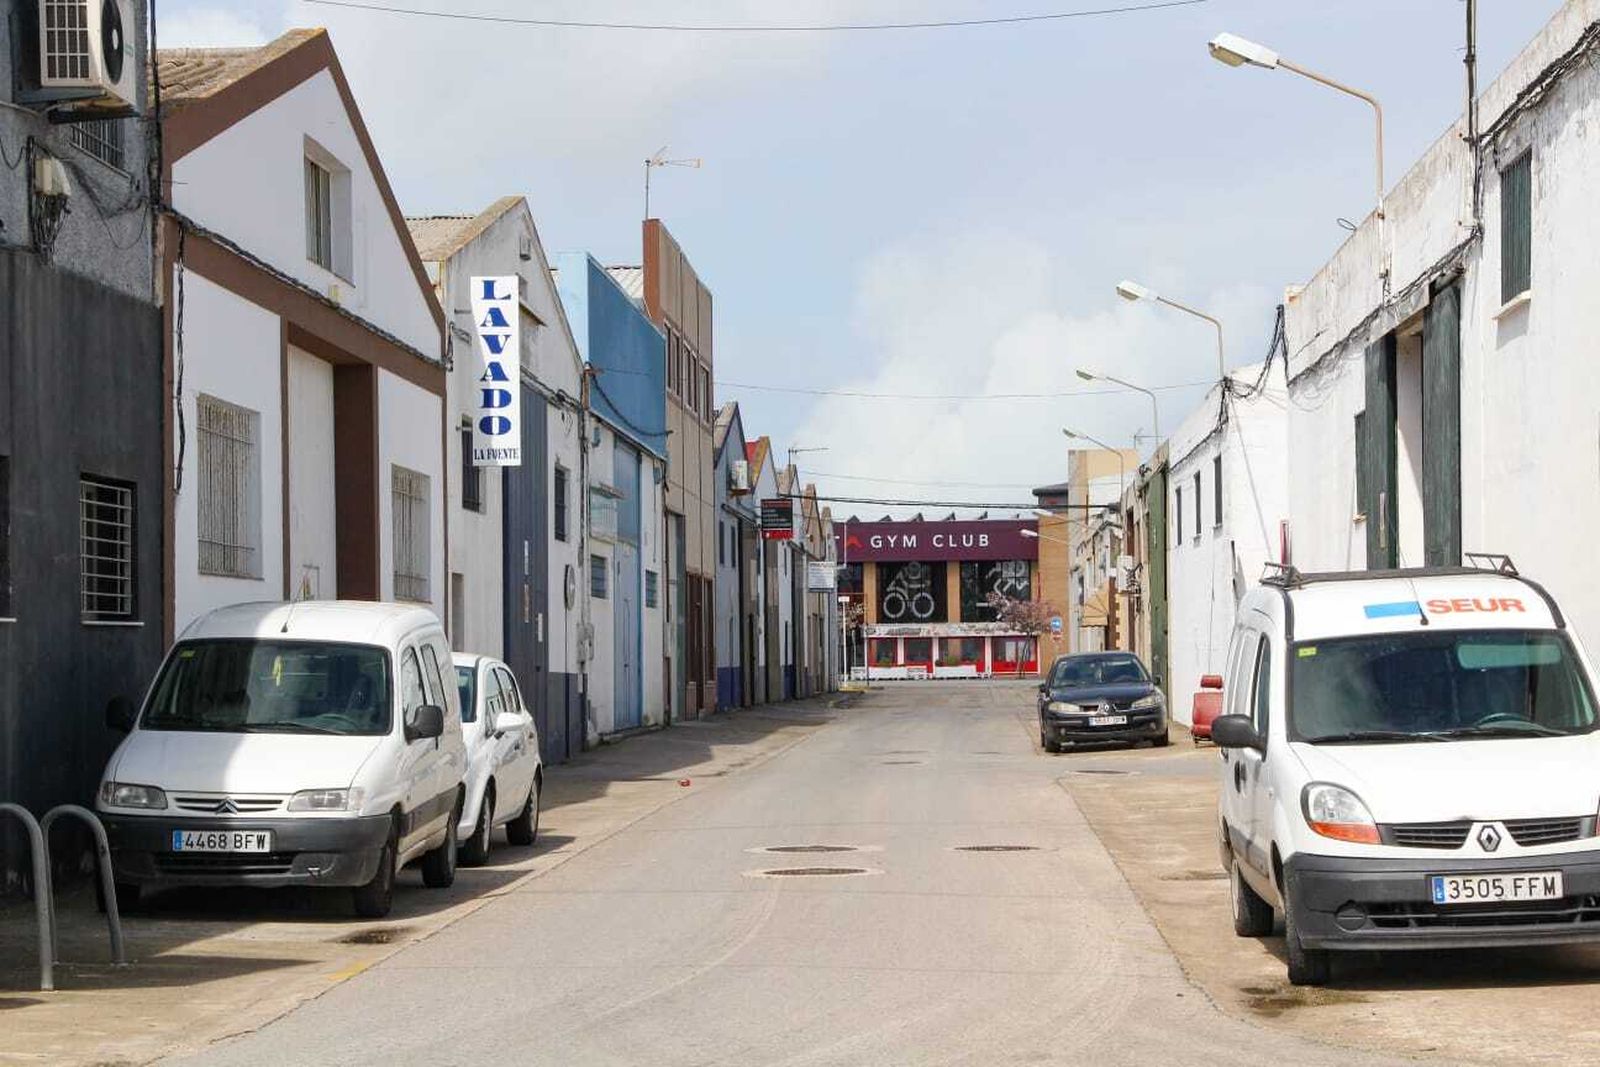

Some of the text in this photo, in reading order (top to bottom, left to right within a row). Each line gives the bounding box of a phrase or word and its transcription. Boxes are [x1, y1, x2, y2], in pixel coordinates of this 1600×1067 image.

[478, 279, 513, 436] LAVADO
[474, 447, 520, 460] LA FUENTE
[870, 533, 990, 549] GYM CLUB
[1426, 597, 1527, 614] SEUR
[185, 832, 267, 850] 4468 BFW
[1448, 877, 1505, 900] 3505
[1512, 875, 1557, 898] FFM
